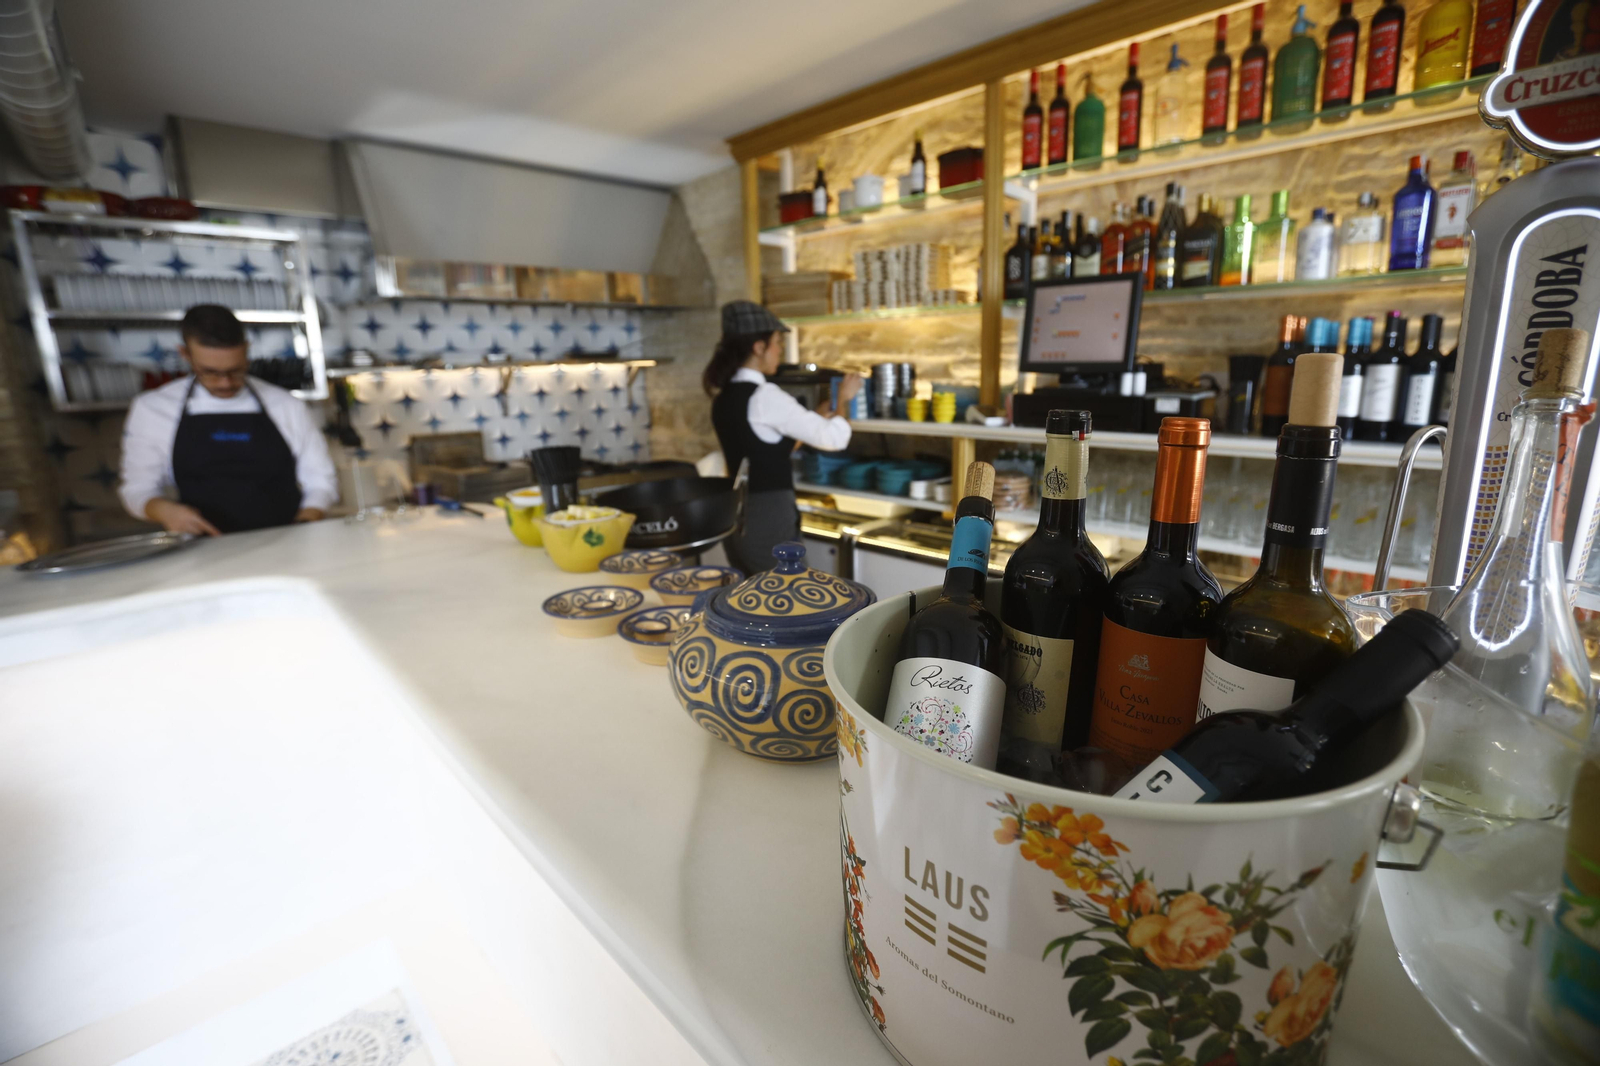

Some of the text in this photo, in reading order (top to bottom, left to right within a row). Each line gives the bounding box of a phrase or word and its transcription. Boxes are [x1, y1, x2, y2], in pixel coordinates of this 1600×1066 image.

[1504, 65, 1600, 103] Cruzc
[631, 515, 679, 535] CELÓ
[910, 664, 973, 694] Rietos
[904, 845, 990, 922] LAUS
[885, 935, 1015, 1025] Aromas del Somontano
